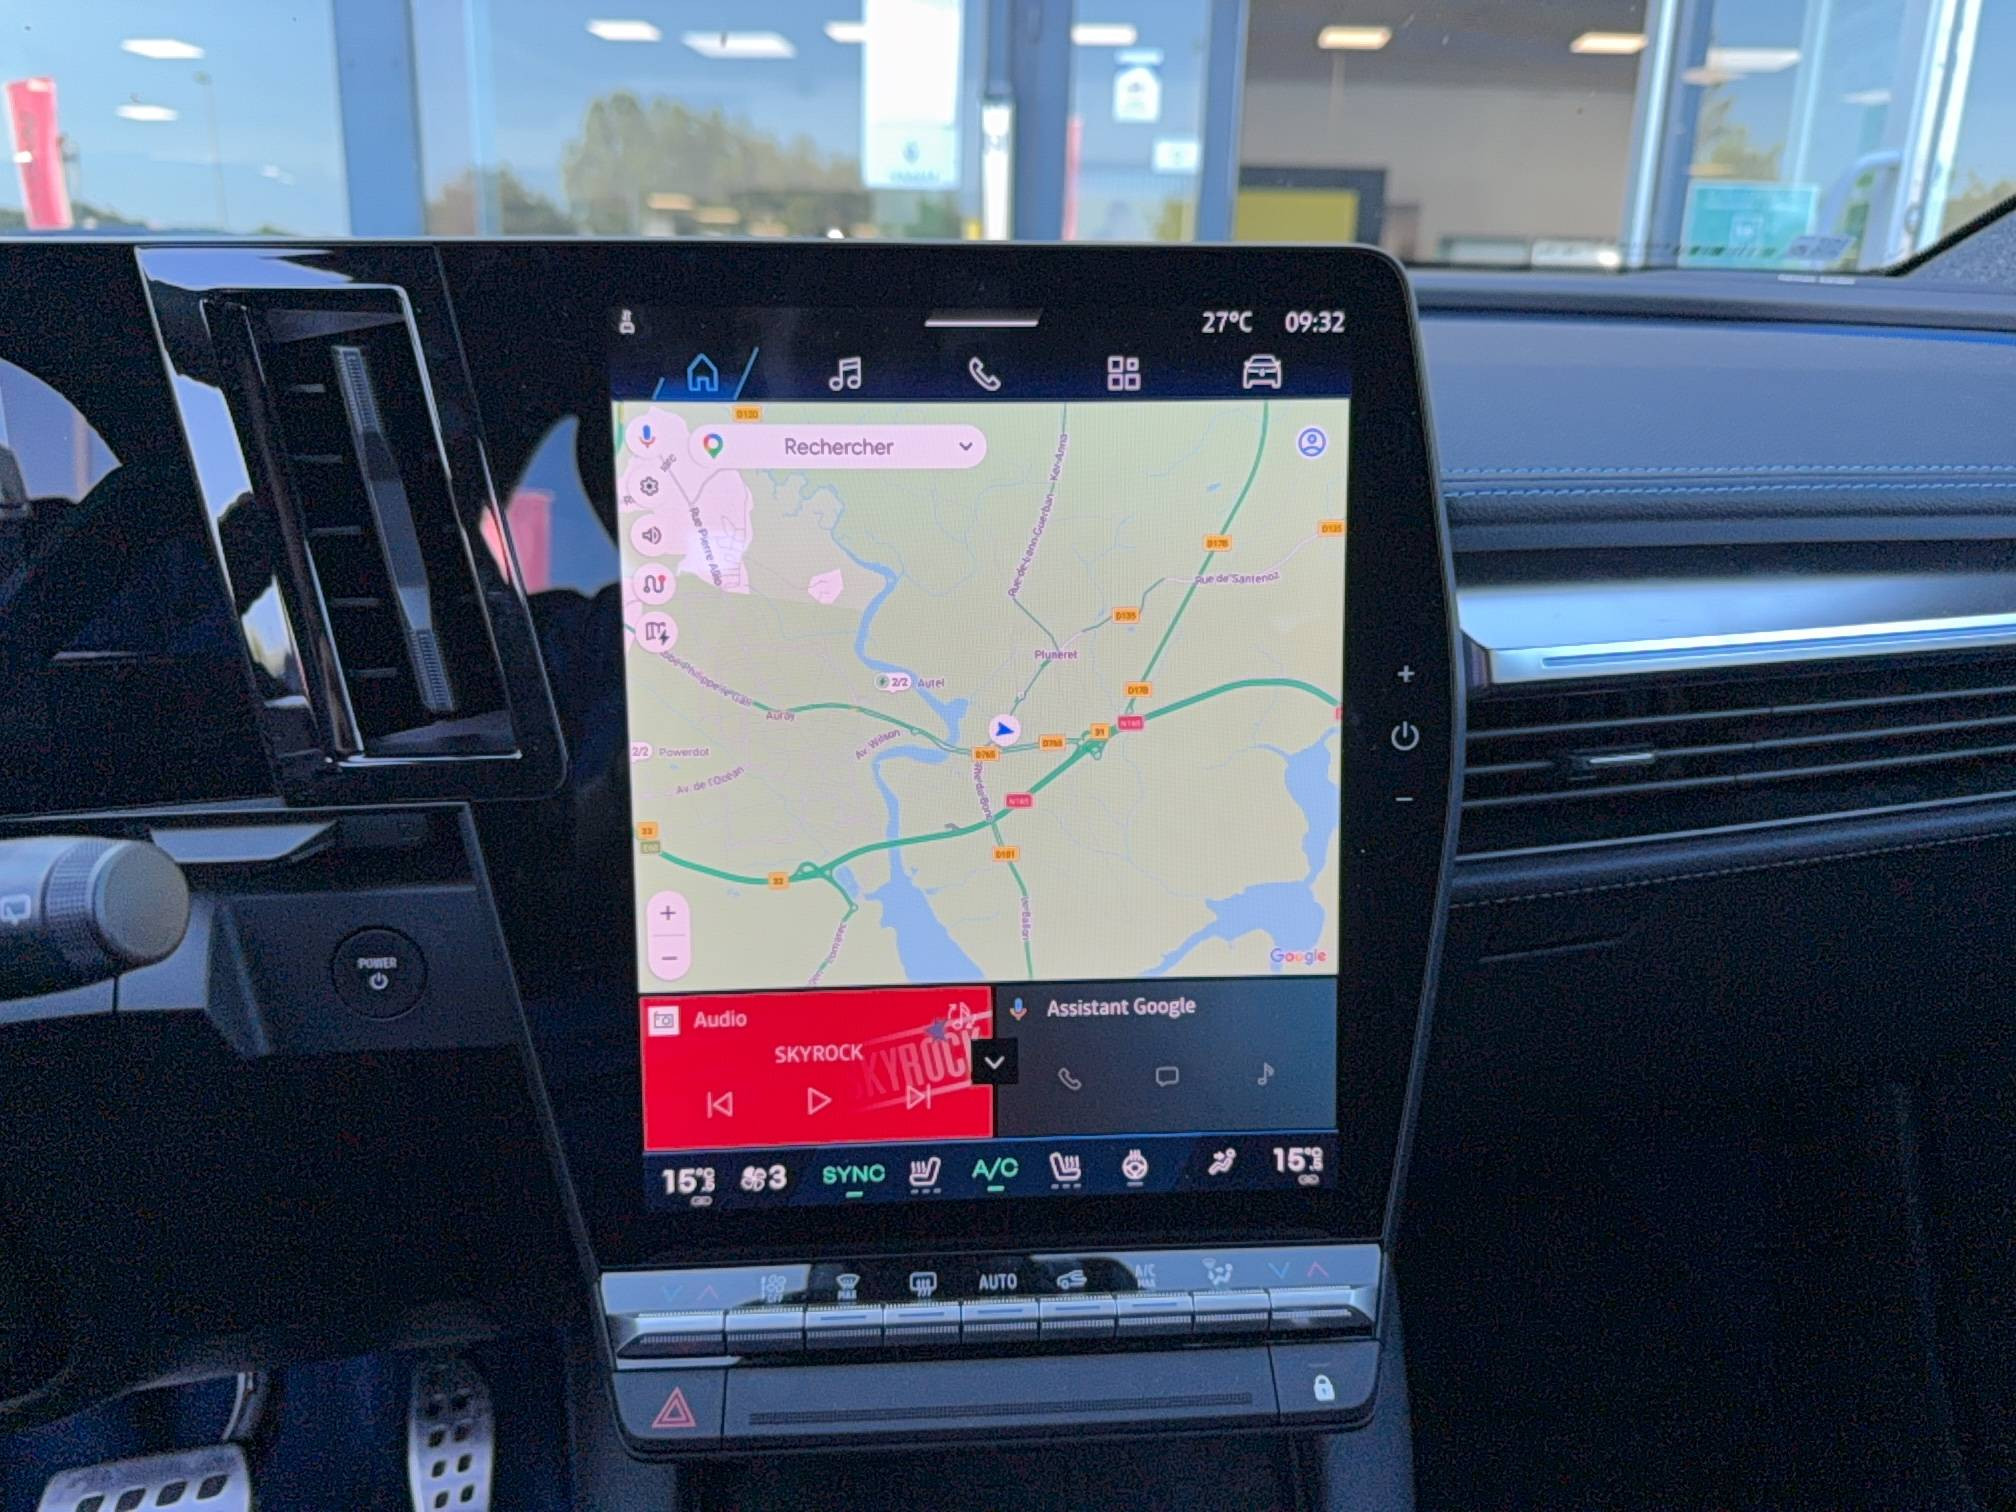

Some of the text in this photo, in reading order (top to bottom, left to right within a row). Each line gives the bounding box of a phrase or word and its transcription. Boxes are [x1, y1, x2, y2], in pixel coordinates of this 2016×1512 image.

[1202, 311, 1252, 333] 27°C
[1285, 311, 1345, 333] 09:32
[785, 438, 894, 456] Rechercher
[1035, 650, 1078, 660] Pluneret
[891, 677, 908, 687] 2/2
[766, 711, 795, 721] Auray
[659, 748, 709, 757] Powerdot
[357, 957, 397, 969] POWER
[1270, 947, 1327, 966] Google
[1047, 996, 1196, 1020] Assistant Google
[694, 1011, 748, 1029] Audio
[774, 1043, 865, 1064] SKYROCK
[768, 1164, 788, 1190] 3
[822, 1163, 886, 1185] SYNC
[972, 1157, 1019, 1181] A/C
[979, 1273, 1017, 1291] AUTO
